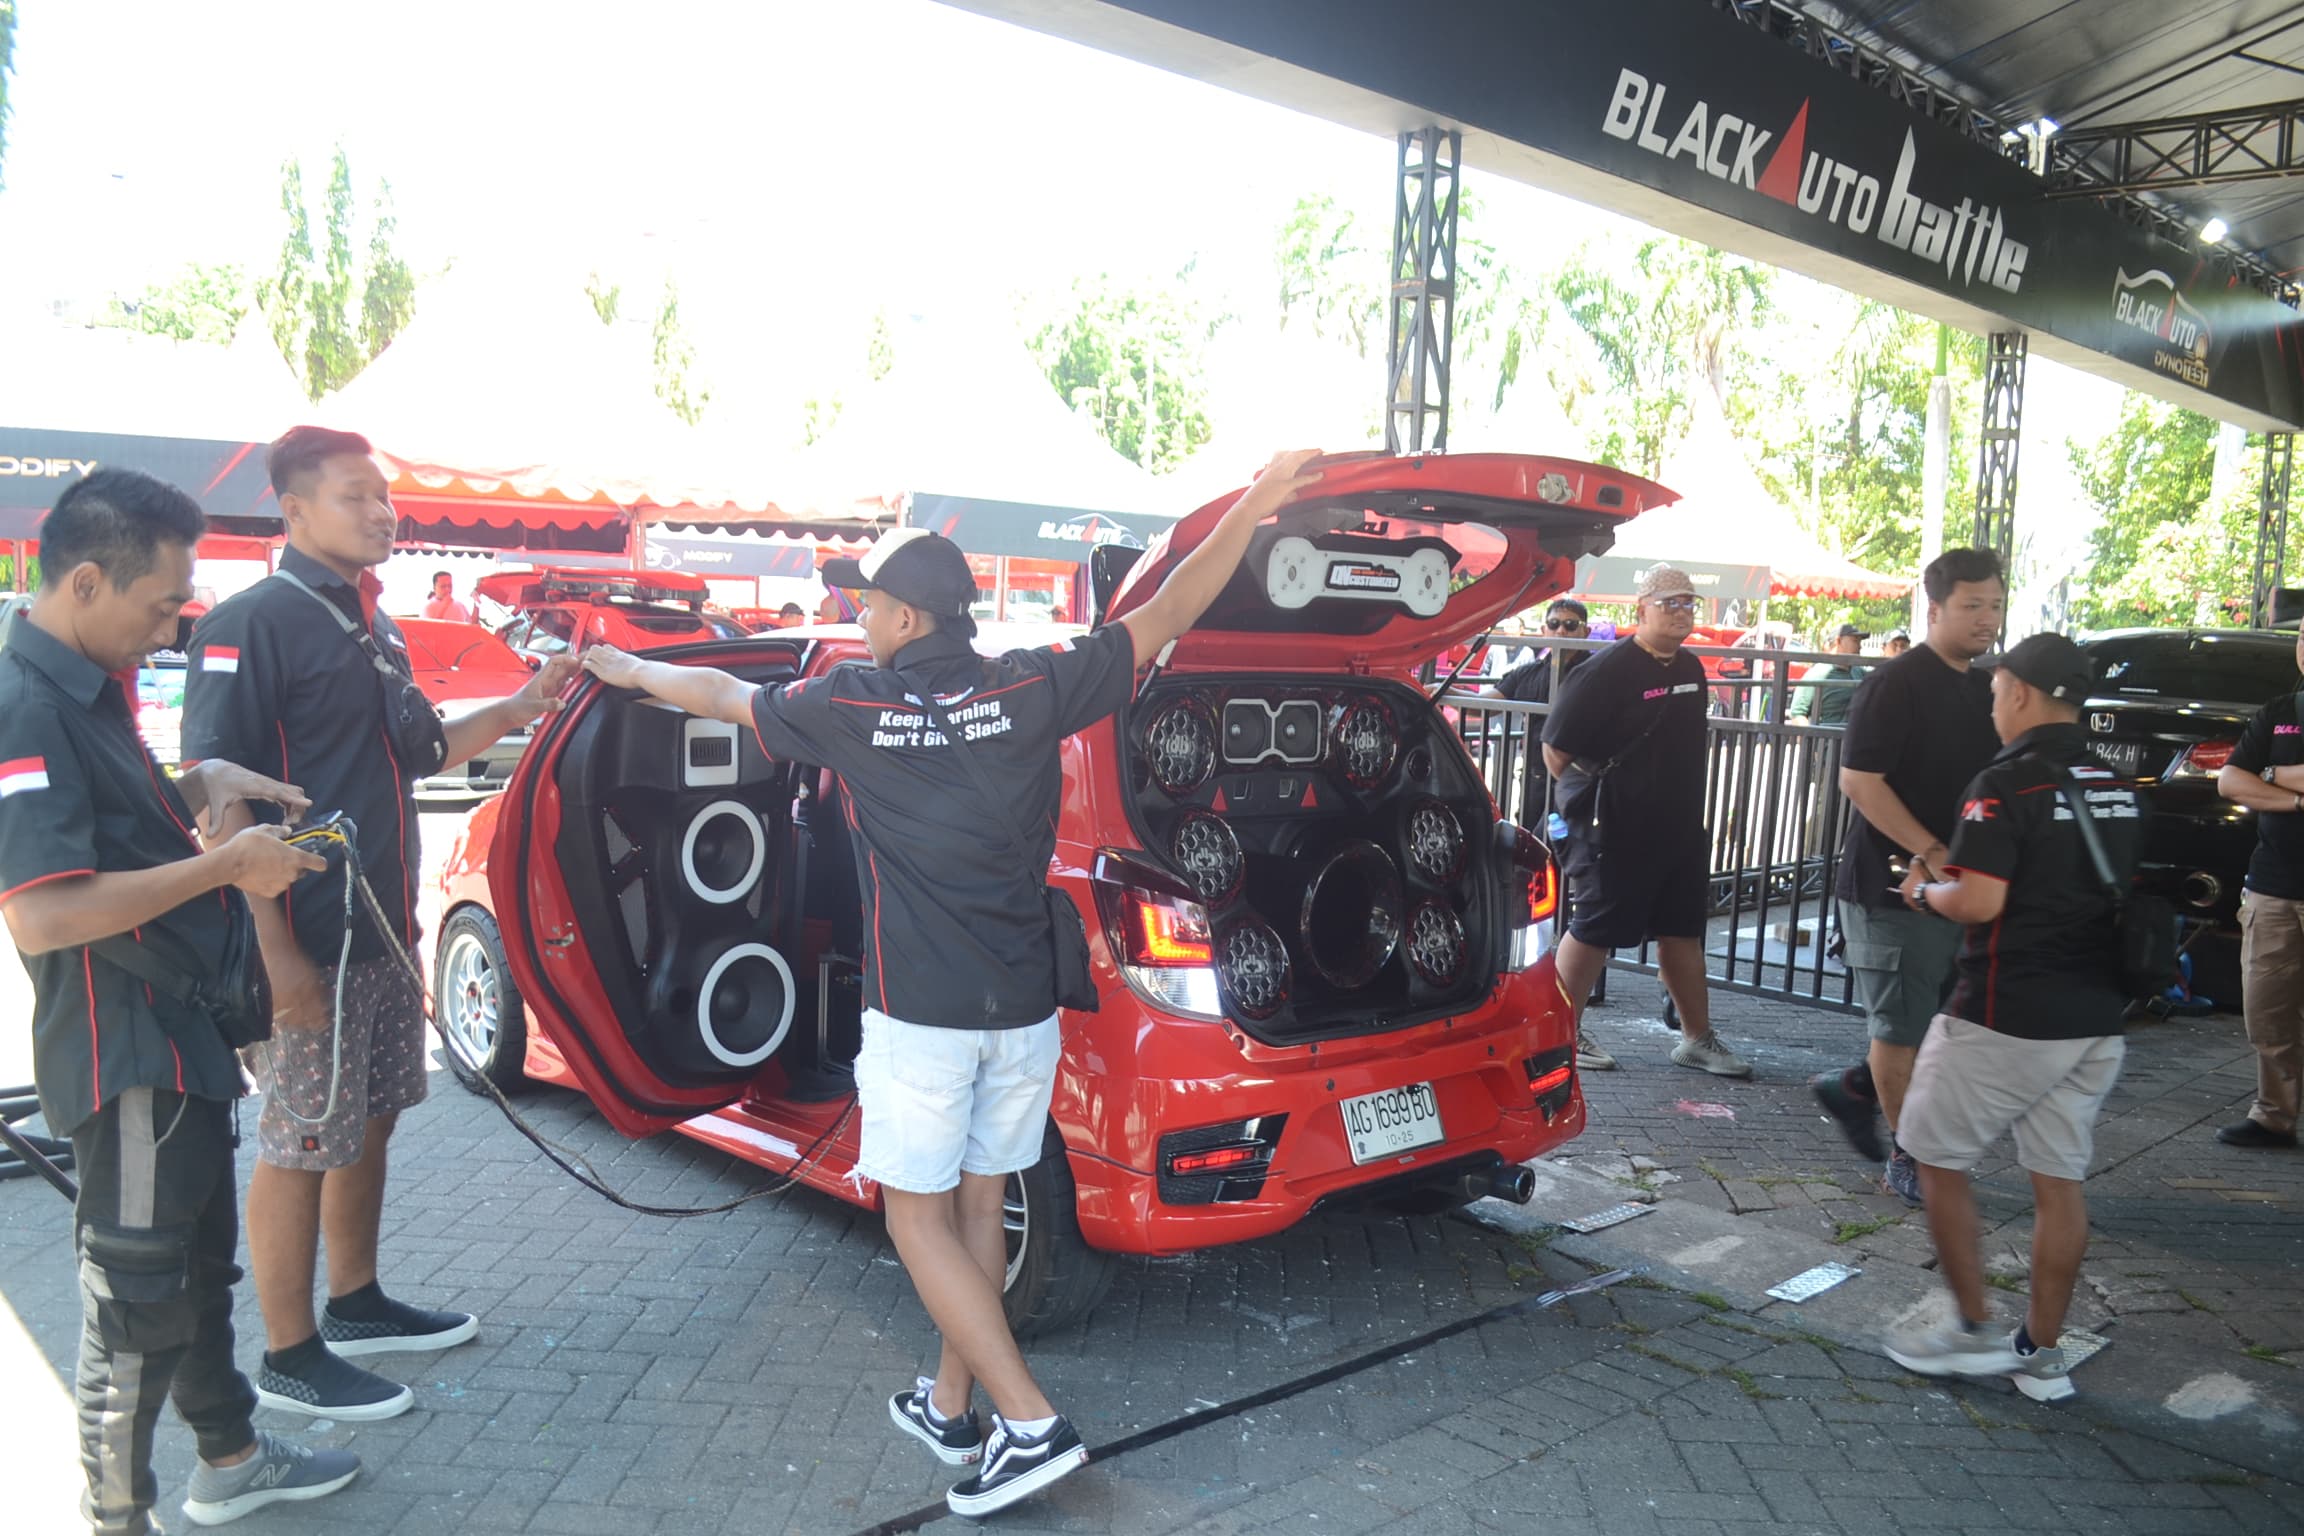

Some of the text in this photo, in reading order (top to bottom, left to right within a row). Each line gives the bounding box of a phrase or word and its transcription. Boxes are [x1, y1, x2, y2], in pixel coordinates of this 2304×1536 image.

[1876, 125, 2029, 294] battle
[879, 700, 1001, 729] Keep Larning
[872, 730, 920, 746] Don't
[964, 715, 1013, 742] Slack
[2125, 745, 2136, 763] H
[1350, 1100, 1373, 1137] AG
[1371, 1091, 1412, 1131] 1699
